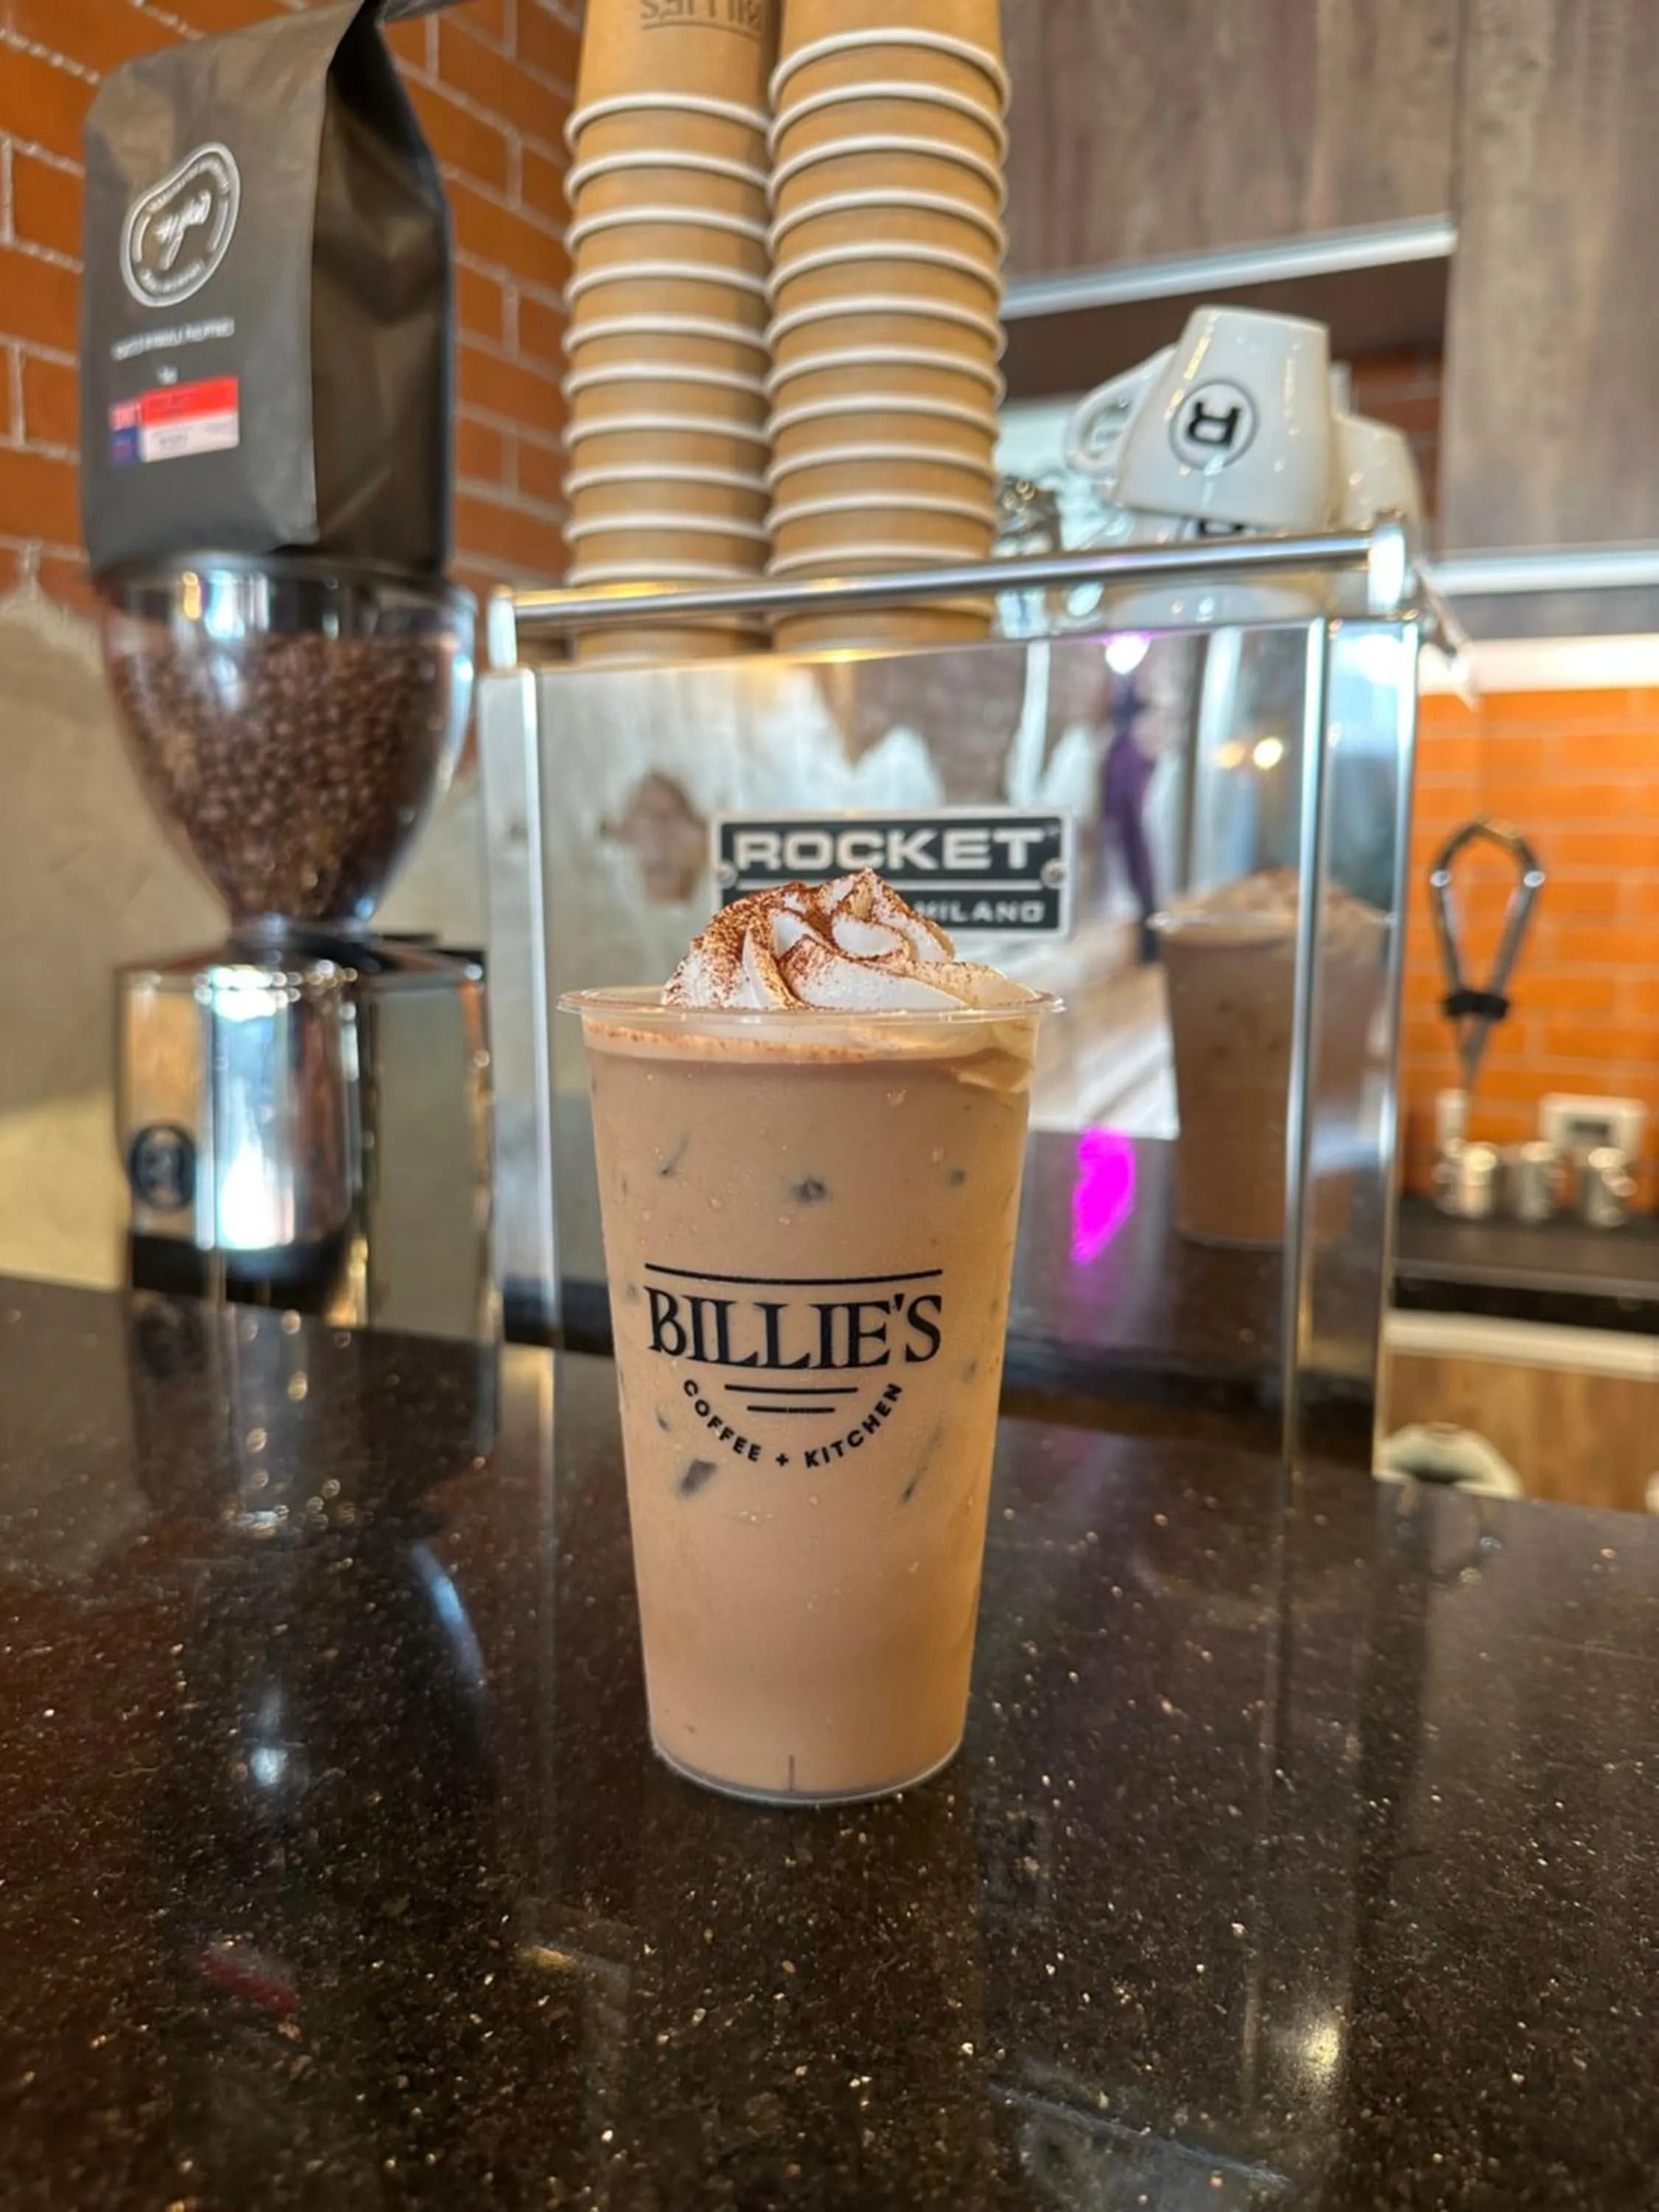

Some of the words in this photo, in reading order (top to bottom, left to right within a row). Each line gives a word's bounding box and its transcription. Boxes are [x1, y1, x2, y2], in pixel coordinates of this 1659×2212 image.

[734, 827, 1045, 871] ROCKET
[644, 1286, 942, 1369] BILLIE'S
[684, 1379, 762, 1462] COFFEE
[804, 1383, 902, 1468] KITCHEN
